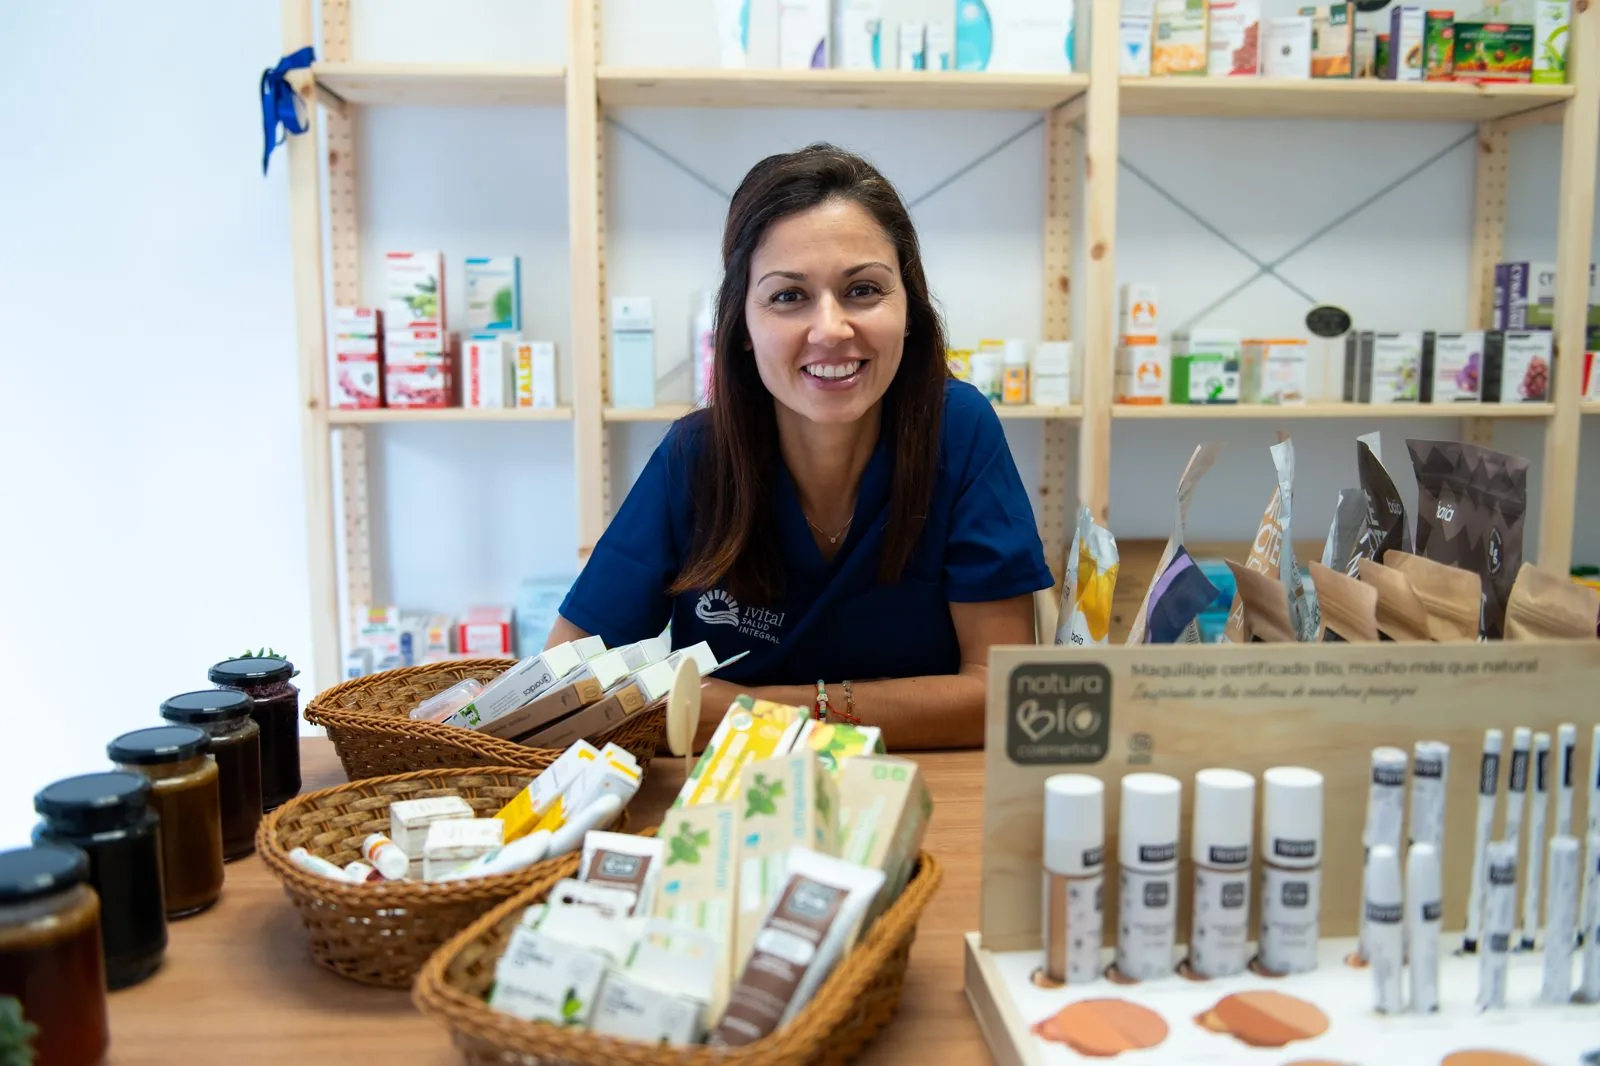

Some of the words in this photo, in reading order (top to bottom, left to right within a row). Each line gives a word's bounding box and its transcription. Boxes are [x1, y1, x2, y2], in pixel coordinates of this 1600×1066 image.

[739, 625, 780, 644] INTEGRAL
[741, 617, 769, 631] SALUD
[1130, 661, 1217, 680] Maquillaje
[1221, 660, 1311, 677] certificado
[1348, 659, 1407, 675] mucho
[1447, 661, 1478, 678] que
[1482, 657, 1540, 674] natural
[1017, 672, 1103, 695] natura
[1016, 699, 1102, 741] Bio
